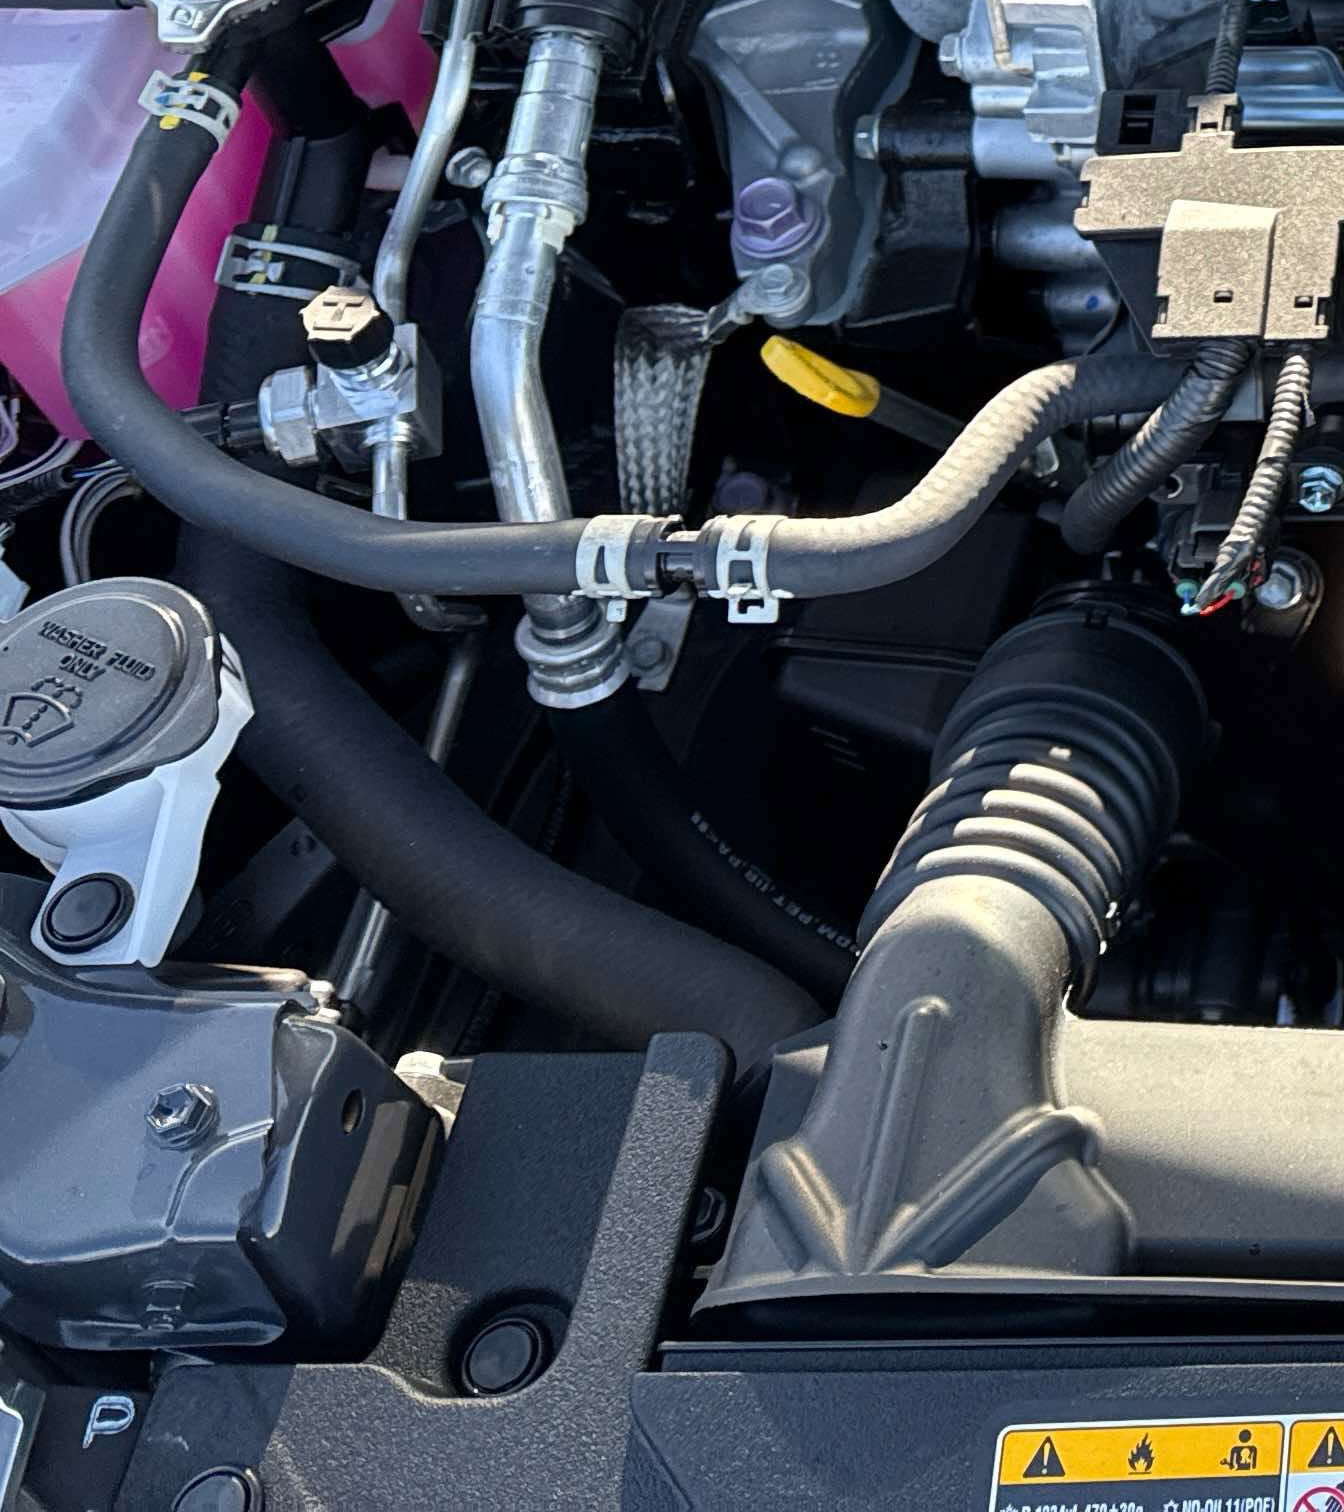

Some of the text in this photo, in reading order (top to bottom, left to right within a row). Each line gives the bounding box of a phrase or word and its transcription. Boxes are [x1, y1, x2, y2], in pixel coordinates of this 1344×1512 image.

[38, 620, 156, 682] WASHER FLUID
[59, 653, 106, 682] ONLY
[83, 1395, 135, 1449] P
